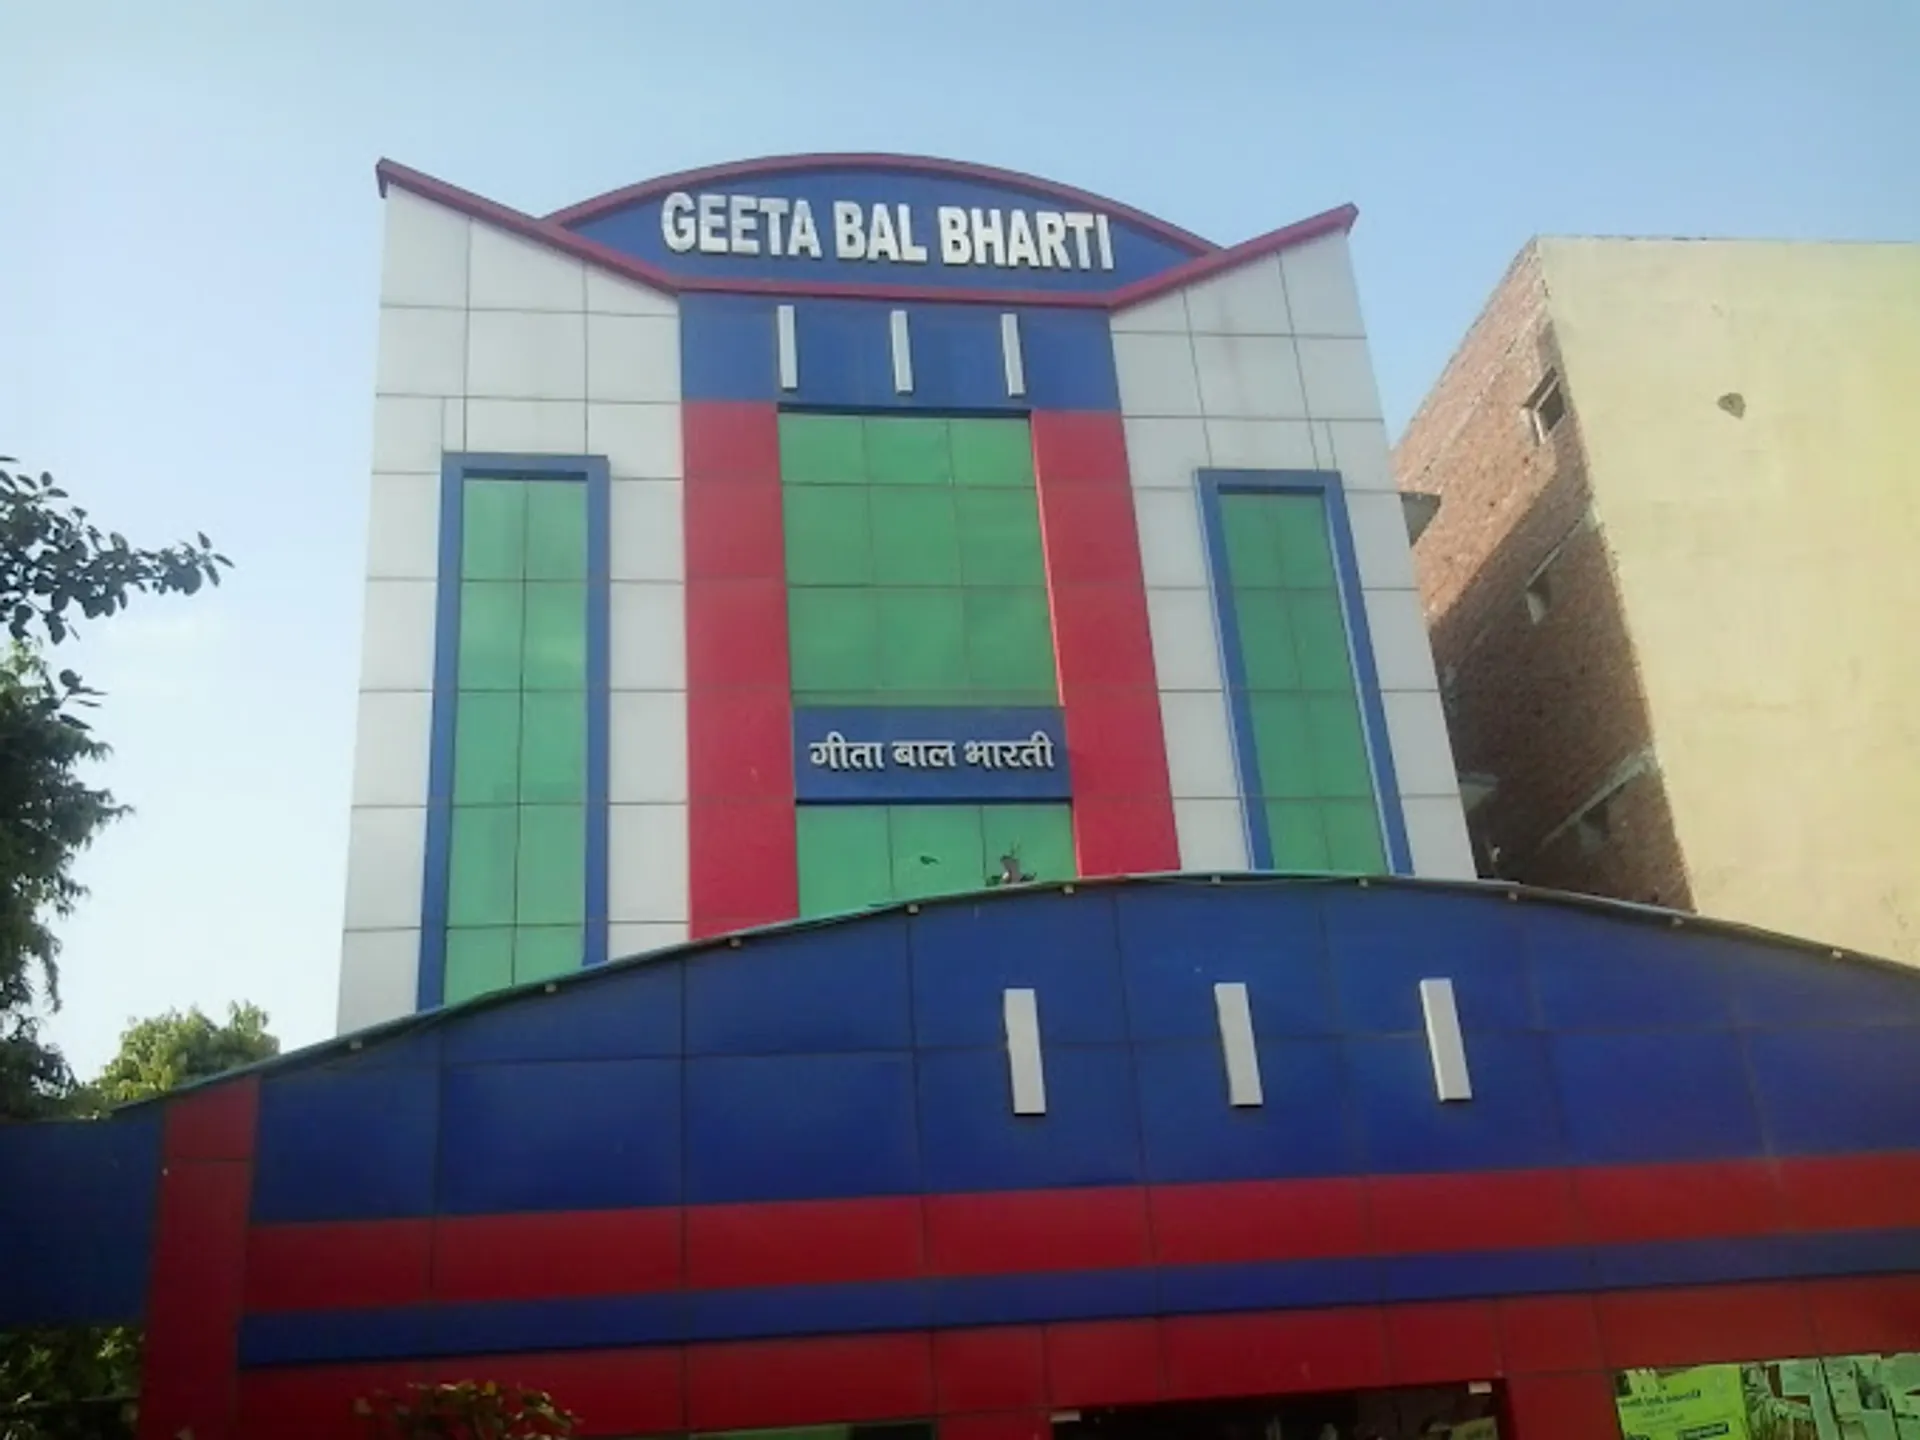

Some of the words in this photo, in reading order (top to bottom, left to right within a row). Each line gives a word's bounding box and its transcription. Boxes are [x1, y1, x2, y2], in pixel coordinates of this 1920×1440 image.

[660, 190, 823, 259] GEETA
[833, 200, 928, 263] BAL
[937, 205, 1115, 270] BHARTI
[809, 731, 885, 770] गीता
[892, 740, 956, 768] बाल
[963, 731, 1055, 769] भारती
